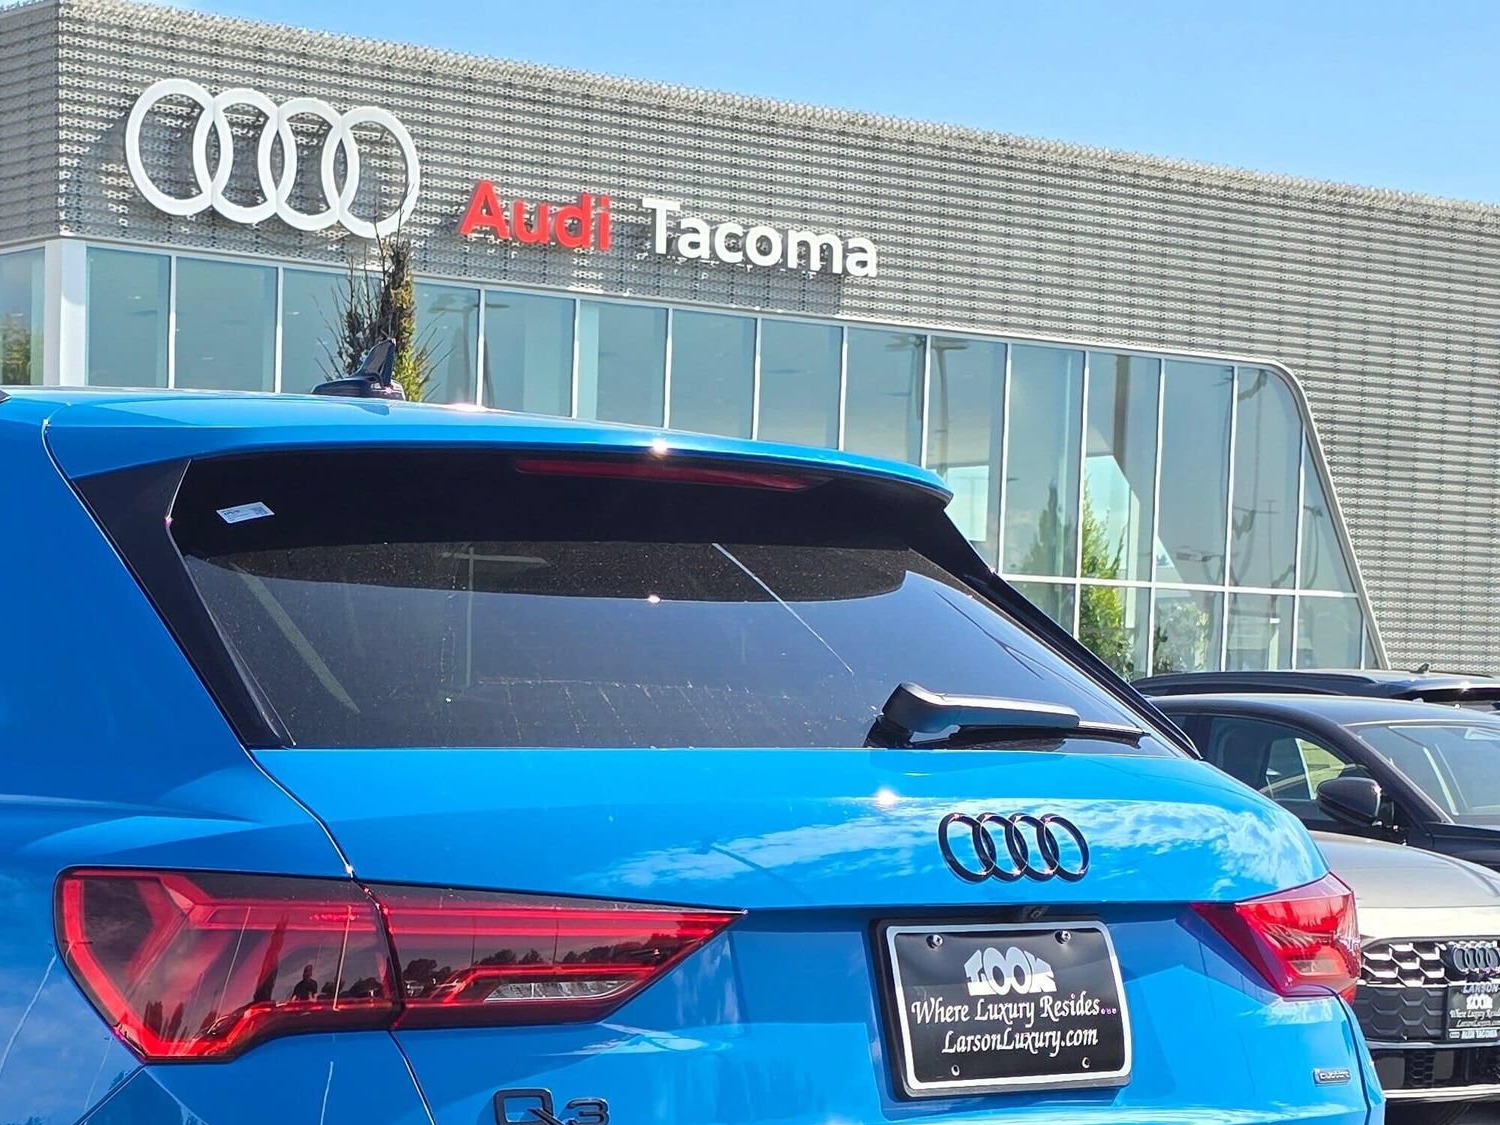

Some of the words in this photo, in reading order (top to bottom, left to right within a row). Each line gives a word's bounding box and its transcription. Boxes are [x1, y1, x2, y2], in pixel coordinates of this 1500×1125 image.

[459, 180, 611, 251] Audi
[642, 198, 878, 278] Tacoma
[911, 997, 970, 1024] Where
[975, 999, 1035, 1028] Luxury
[1040, 991, 1117, 1018] Resides...
[941, 1027, 1098, 1057] LarsonLuxury.com
